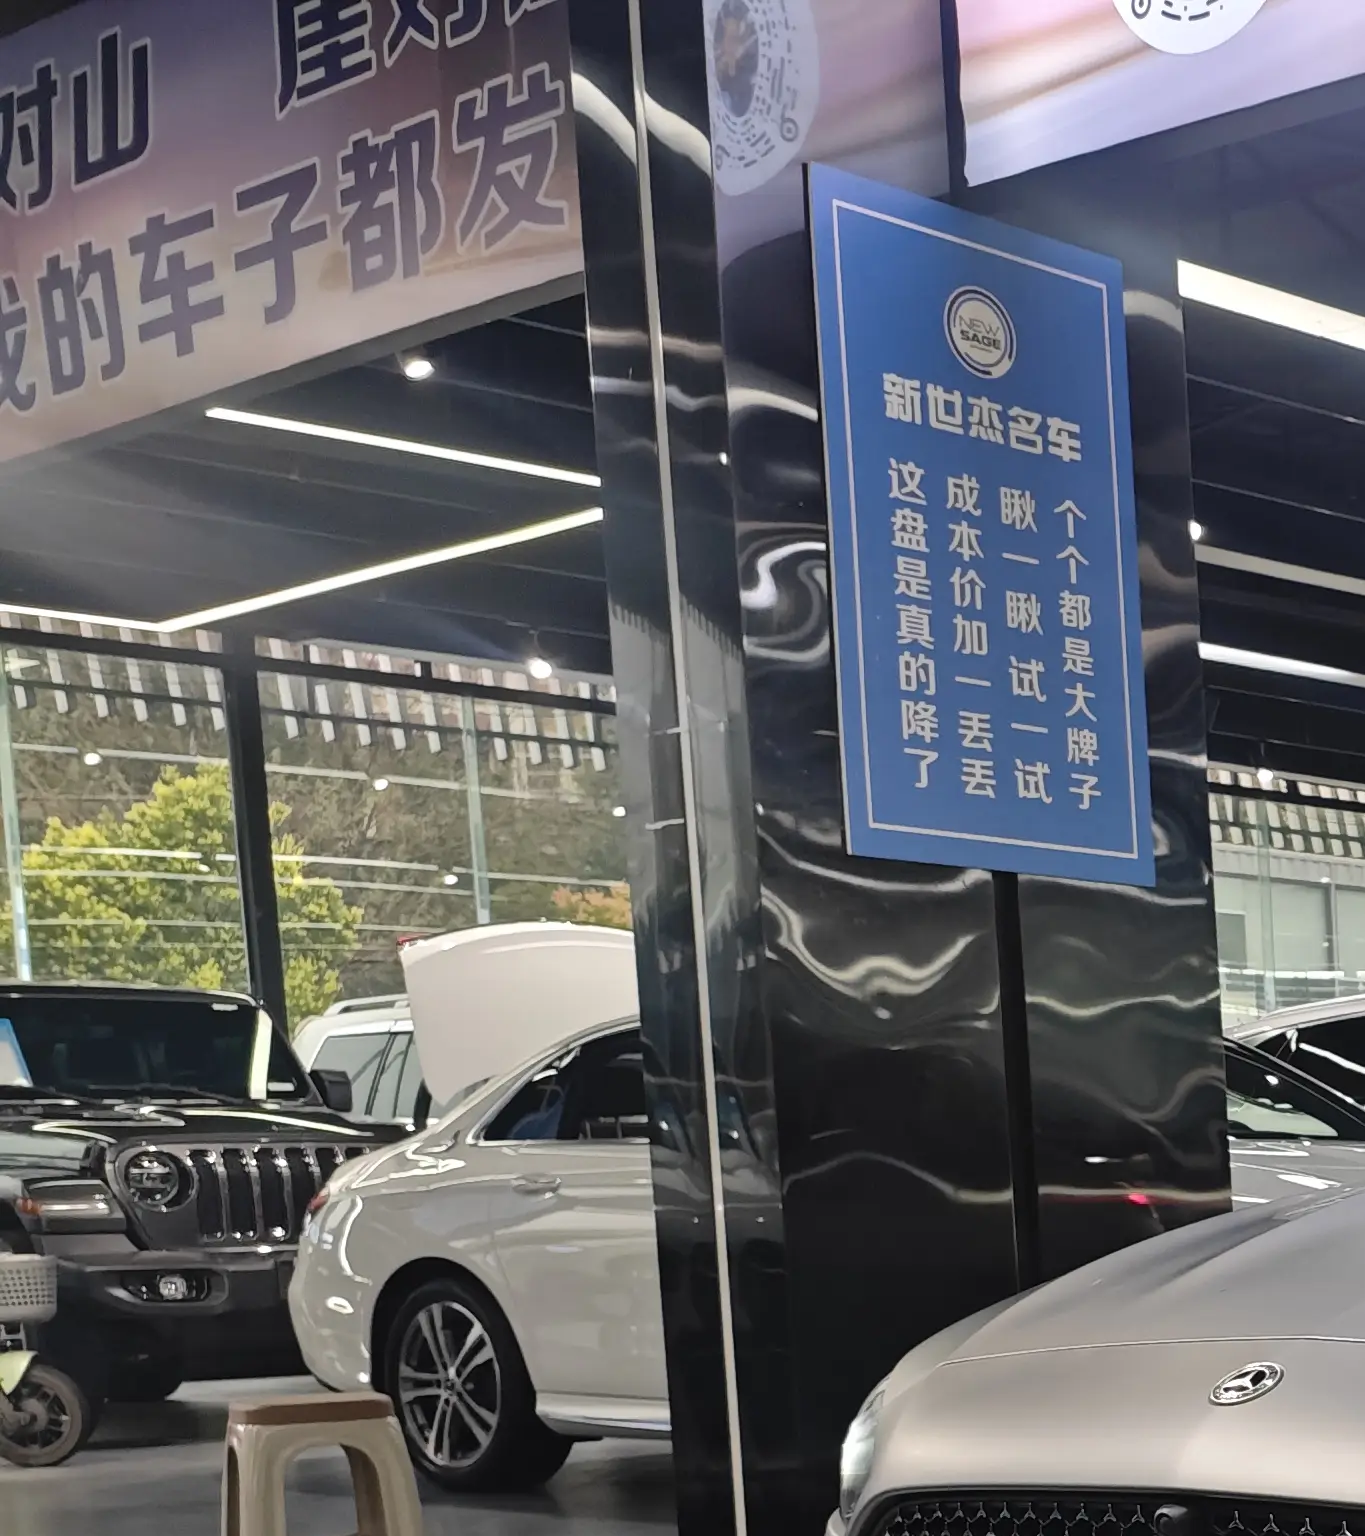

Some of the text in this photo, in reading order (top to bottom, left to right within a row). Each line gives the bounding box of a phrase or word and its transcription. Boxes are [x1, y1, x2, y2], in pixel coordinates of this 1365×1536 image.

[883, 373, 1081, 462] 新世杰名车
[959, 315, 1000, 337] NEW
[960, 330, 1001, 351] SAGE
[888, 457, 939, 788] 这盘是真的降了
[947, 473, 996, 799] 成本价加一丢丢
[1000, 486, 1052, 804] 瞅一瞅试一试
[1054, 499, 1101, 810] 个个都是大牌子
